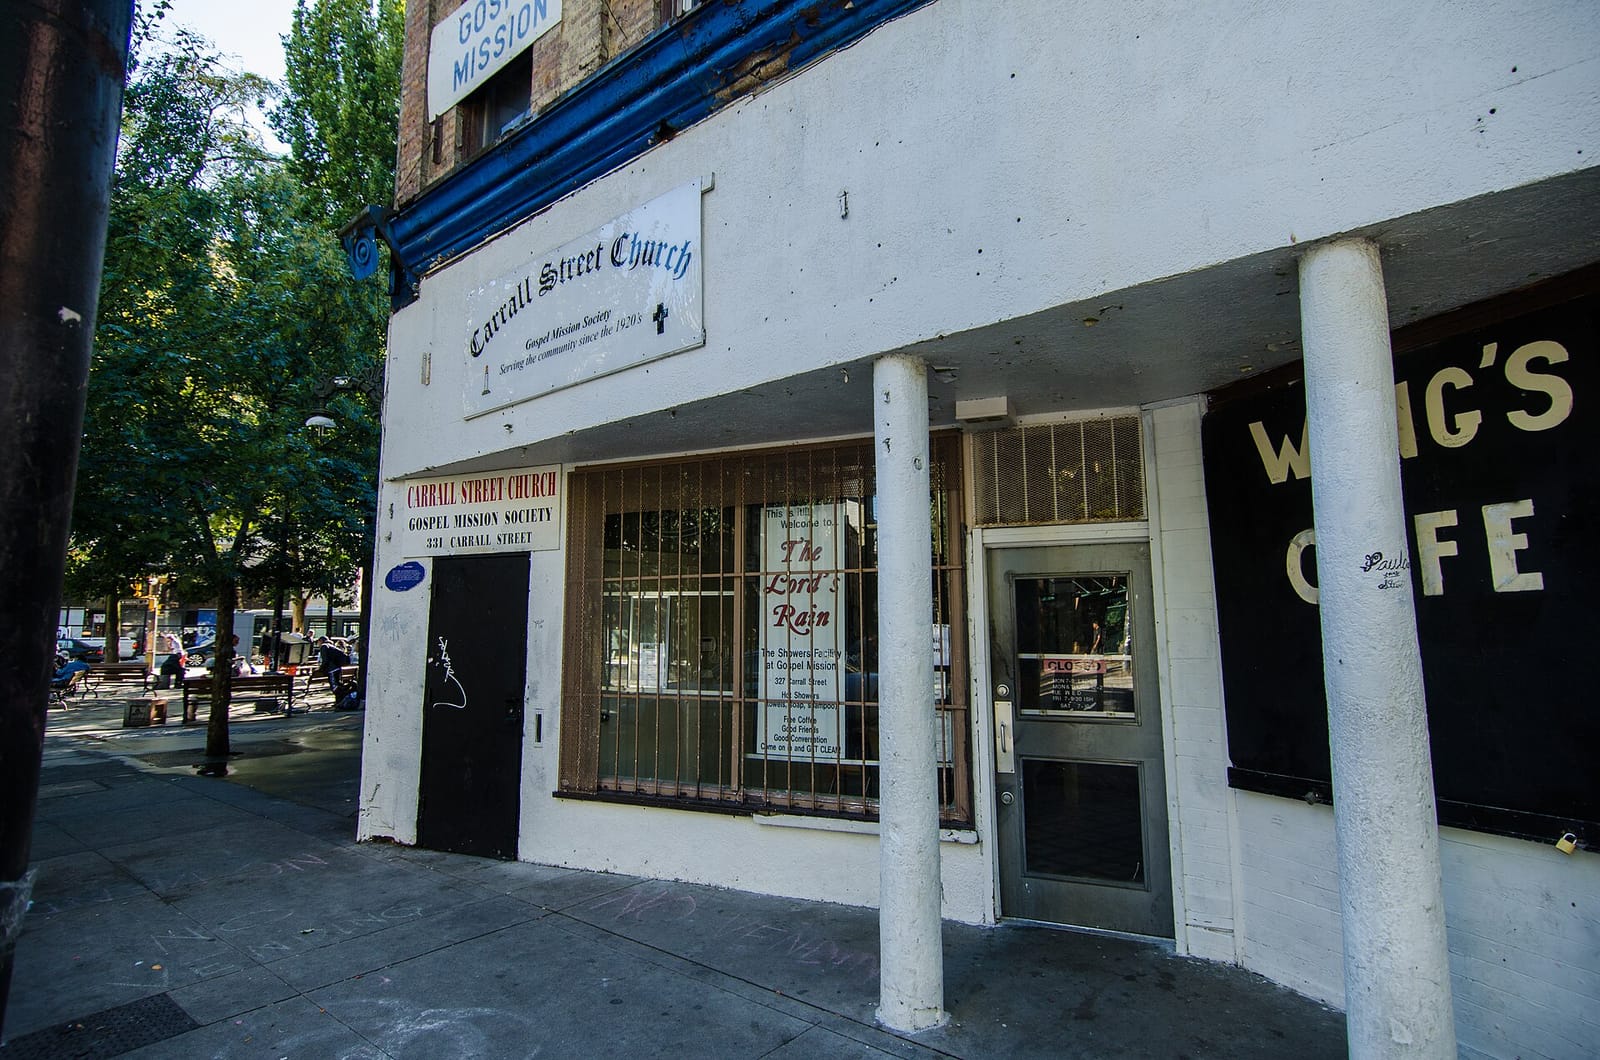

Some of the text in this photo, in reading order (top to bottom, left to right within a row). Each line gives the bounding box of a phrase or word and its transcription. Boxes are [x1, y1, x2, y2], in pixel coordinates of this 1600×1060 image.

[459, 0, 508, 45] GOS
[453, 0, 547, 92] MISSION
[470, 232, 692, 358] Carrall Street Church
[525, 309, 612, 351] Gospel Mission Society
[499, 312, 643, 376] Serving the community since the 1920's
[1249, 340, 1574, 484] WG'S
[407, 471, 557, 508] CARRALL STREET CHURCH
[409, 507, 553, 531] GOSPEL MISSION SOCIETY
[766, 509, 783, 519] This
[780, 519, 819, 529] Welcome
[426, 531, 533, 549] 331 CARRALL STREET
[781, 536, 823, 563] The
[1286, 498, 1544, 605] CFE
[763, 572, 841, 595] Lord's
[773, 604, 830, 636] Rain
[777, 647, 811, 658] Showers
[814, 648, 842, 659] Faciliy
[776, 660, 804, 672] Gopel
[807, 660, 838, 671] Mission
[774, 677, 786, 685] 327
[808, 678, 827, 686] Sreet
[789, 702, 806, 711] oap,
[807, 702, 839, 711] sampoo)
[794, 690, 820, 700] Showrs
[760, 742, 776, 751] Cme
[806, 744, 818, 753] GT
